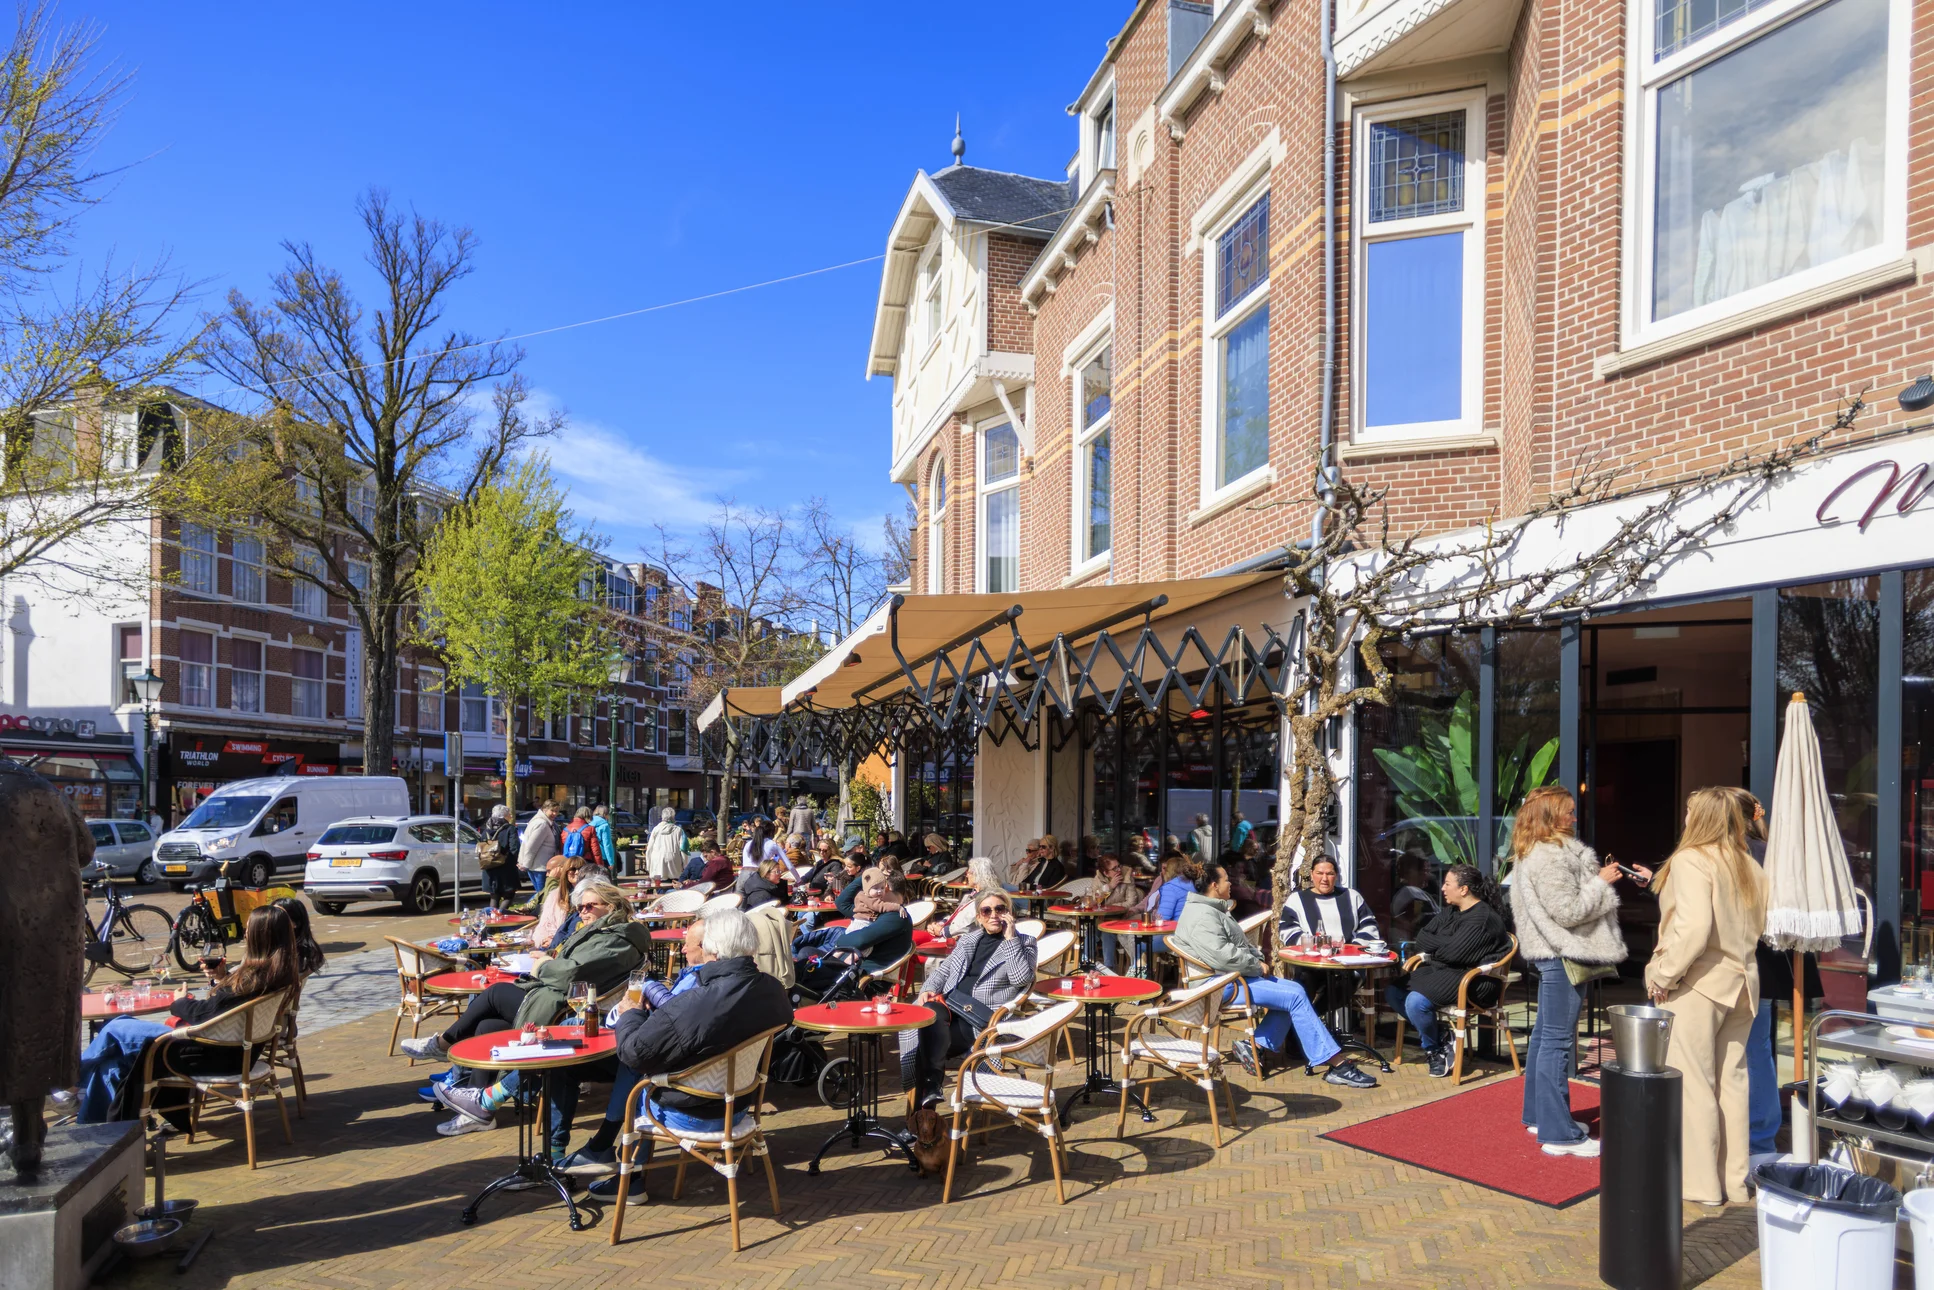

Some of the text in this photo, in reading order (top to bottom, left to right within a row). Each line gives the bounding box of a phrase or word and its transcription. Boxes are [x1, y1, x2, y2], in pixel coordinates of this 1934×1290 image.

[231, 743, 262, 752] SWIMMING
[180, 751, 219, 761] TRIATHLON
[177, 781, 214, 789] FOREVER
